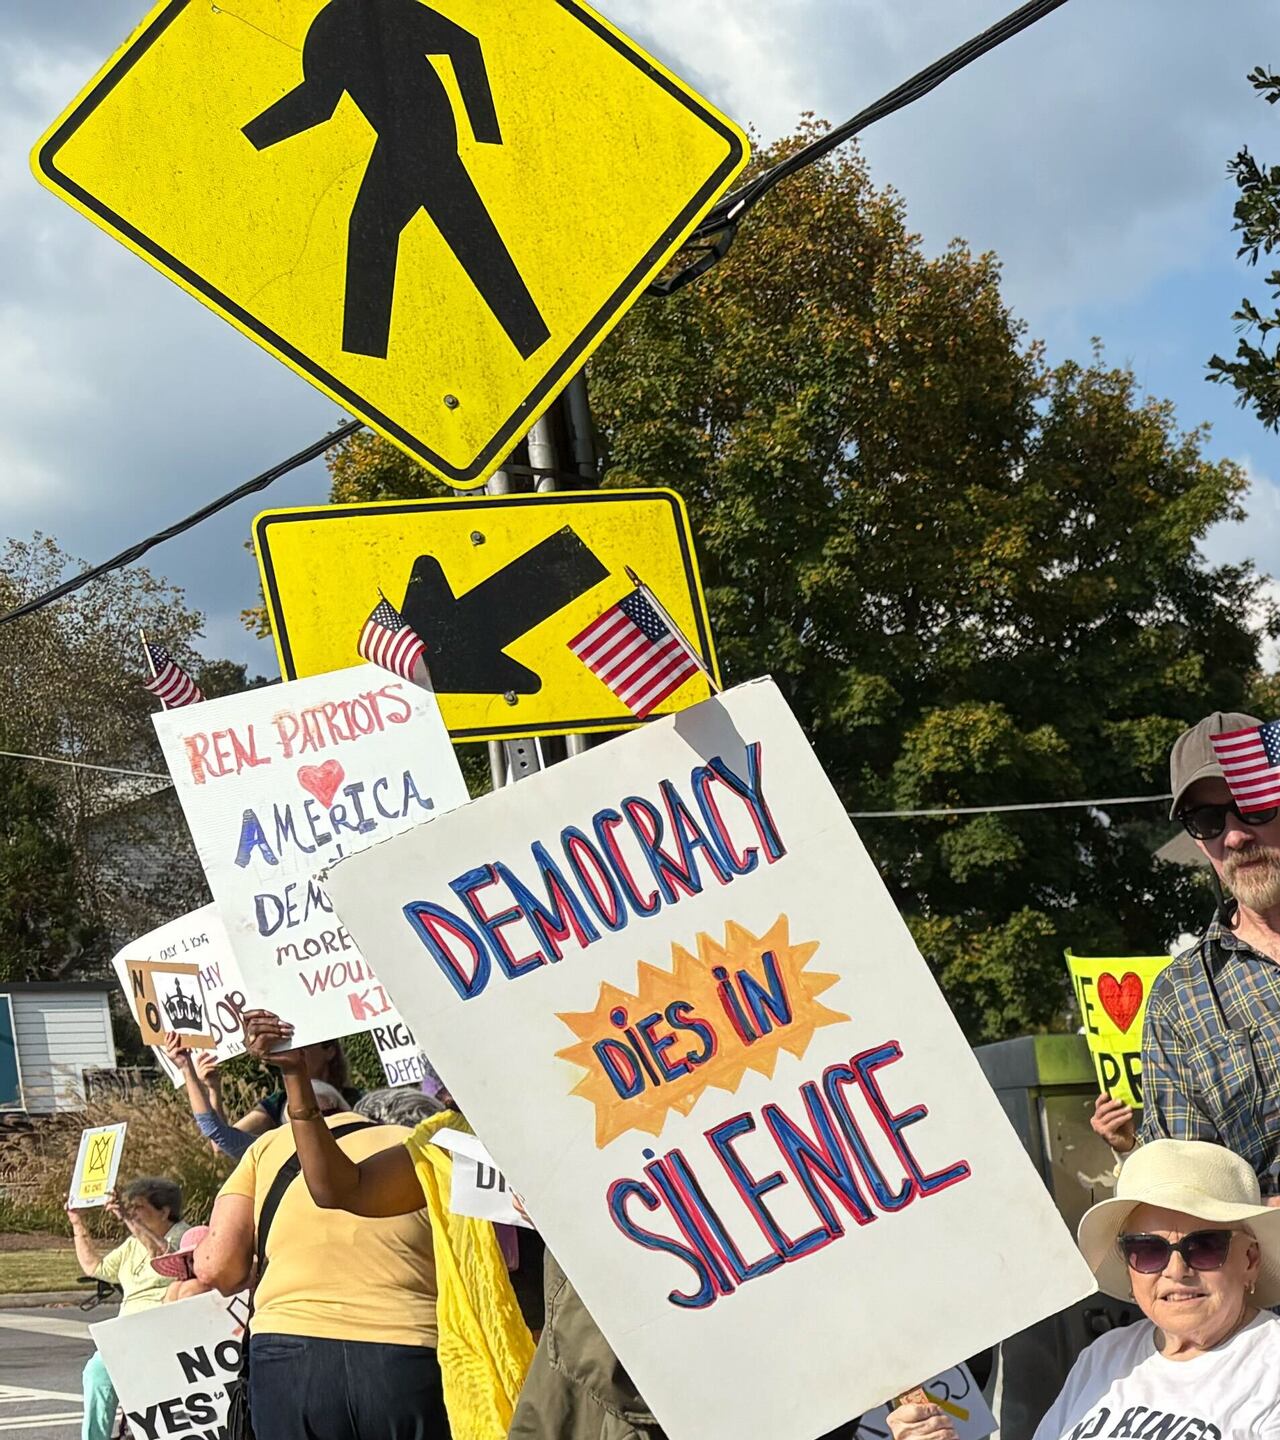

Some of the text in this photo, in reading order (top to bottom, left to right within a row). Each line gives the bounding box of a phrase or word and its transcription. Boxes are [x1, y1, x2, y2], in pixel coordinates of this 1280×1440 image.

[272, 683, 412, 759] PATRIOTS
[234, 770, 435, 868] AMERICA
[402, 740, 789, 1001] DEMOCRACY
[199, 962, 224, 991] HY
[1075, 974, 1099, 1036] E
[127, 1392, 218, 1440] YES
